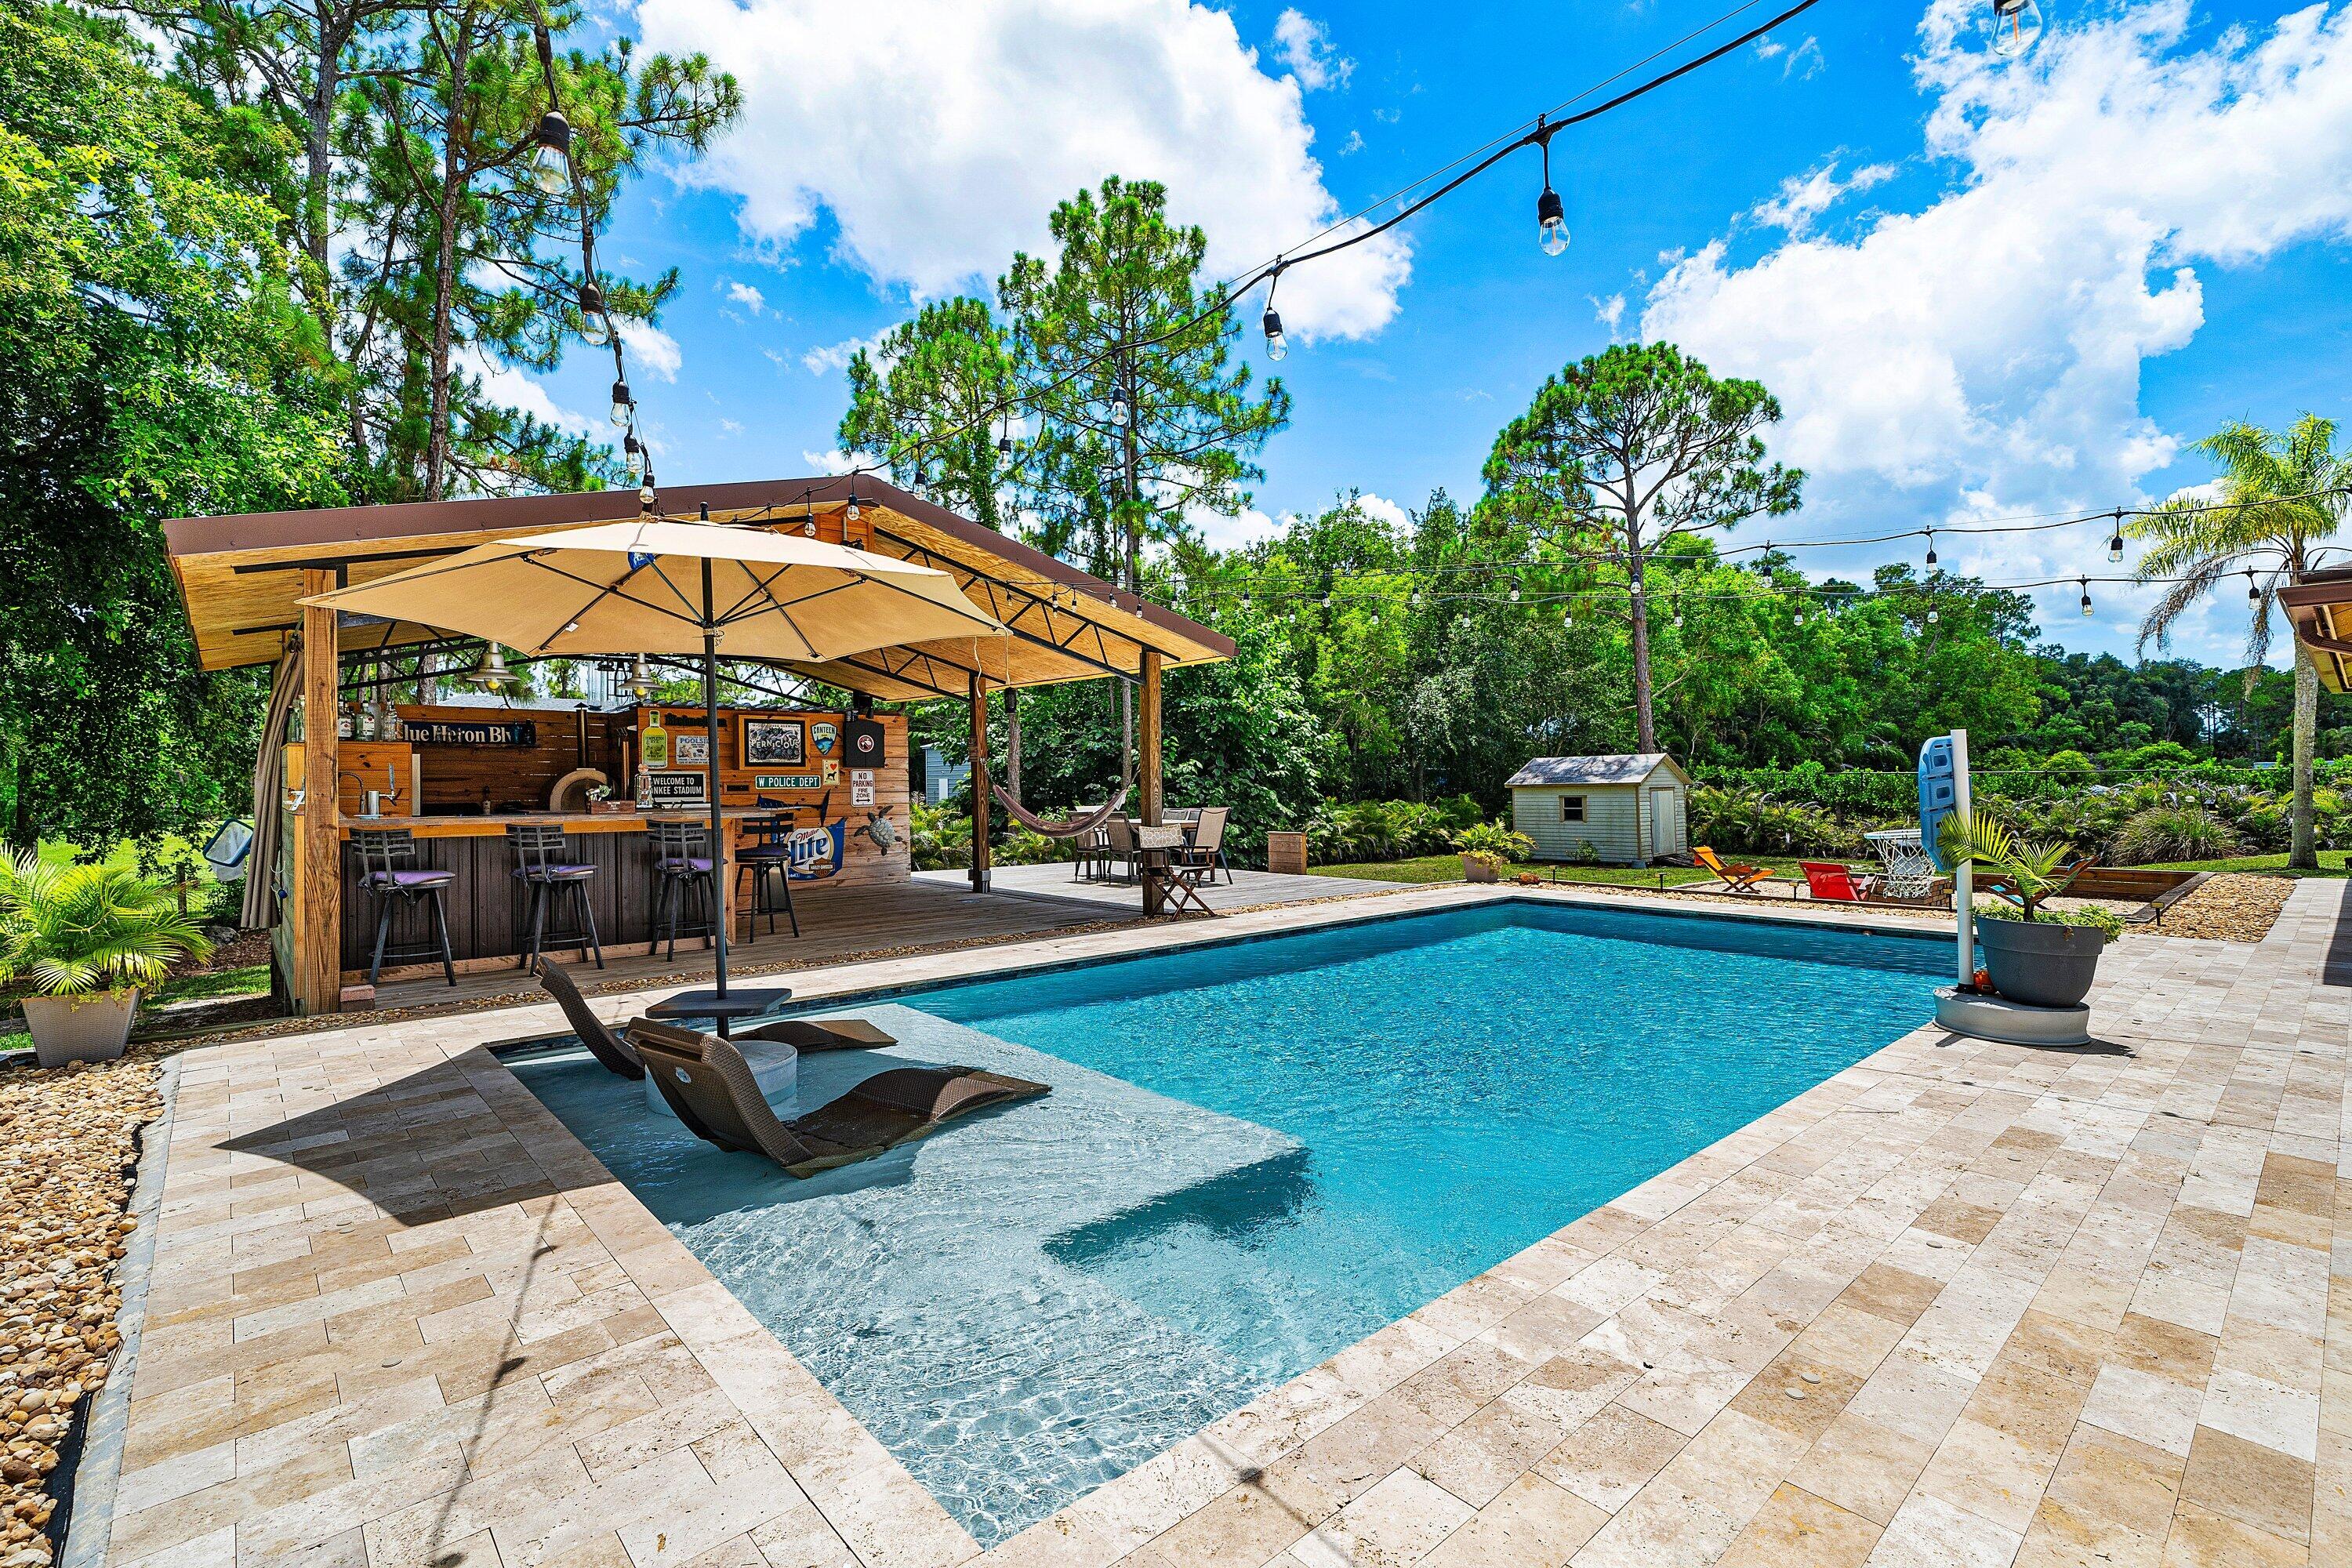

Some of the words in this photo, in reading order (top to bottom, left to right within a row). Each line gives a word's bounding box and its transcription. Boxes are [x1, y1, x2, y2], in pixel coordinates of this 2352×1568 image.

[431, 724, 485, 742] Heron
[488, 726, 512, 742] Blv
[751, 738, 800, 750] PERNICIOUS
[652, 777, 685, 786] WELCOME
[758, 777, 765, 787] W
[768, 777, 795, 787] POLICE
[799, 777, 818, 787] DEPT
[673, 786, 702, 794] STADIUM
[796, 829, 820, 843] Miller
